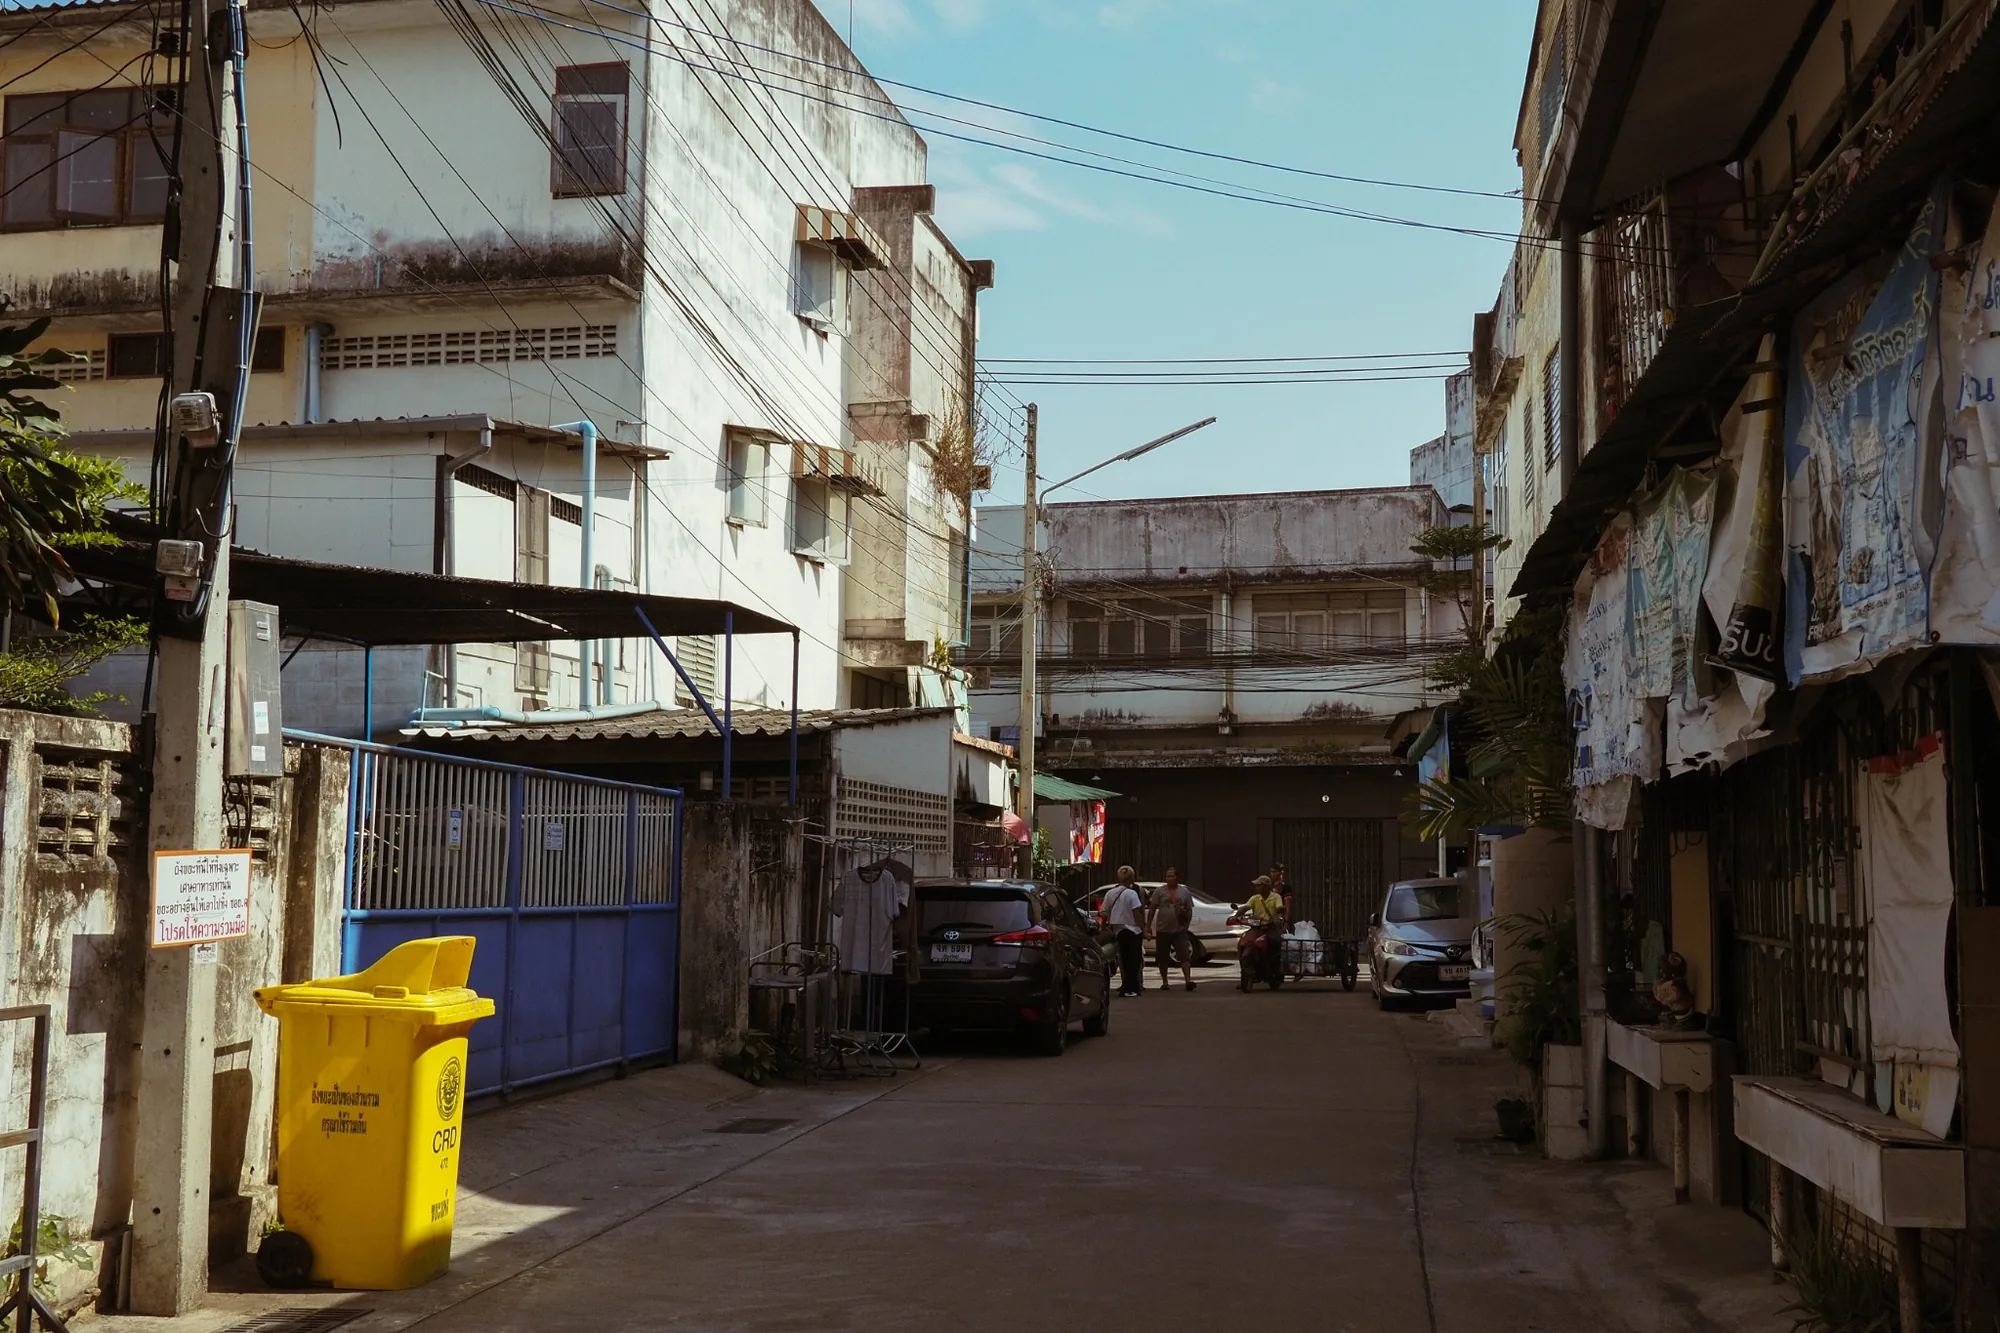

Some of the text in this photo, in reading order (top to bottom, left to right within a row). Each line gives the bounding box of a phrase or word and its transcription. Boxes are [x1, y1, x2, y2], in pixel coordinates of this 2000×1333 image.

[180, 876, 232, 895] เศษอาหารเท่านั้น
[159, 914, 246, 942] โปรดให้ความร่วมมือ
[311, 1081, 380, 1108] ถังขยะเป็นของส่วนรวม
[321, 1110, 367, 1140] กรุณาใช้ร่วมกัน
[432, 1126, 457, 1154] CRD
